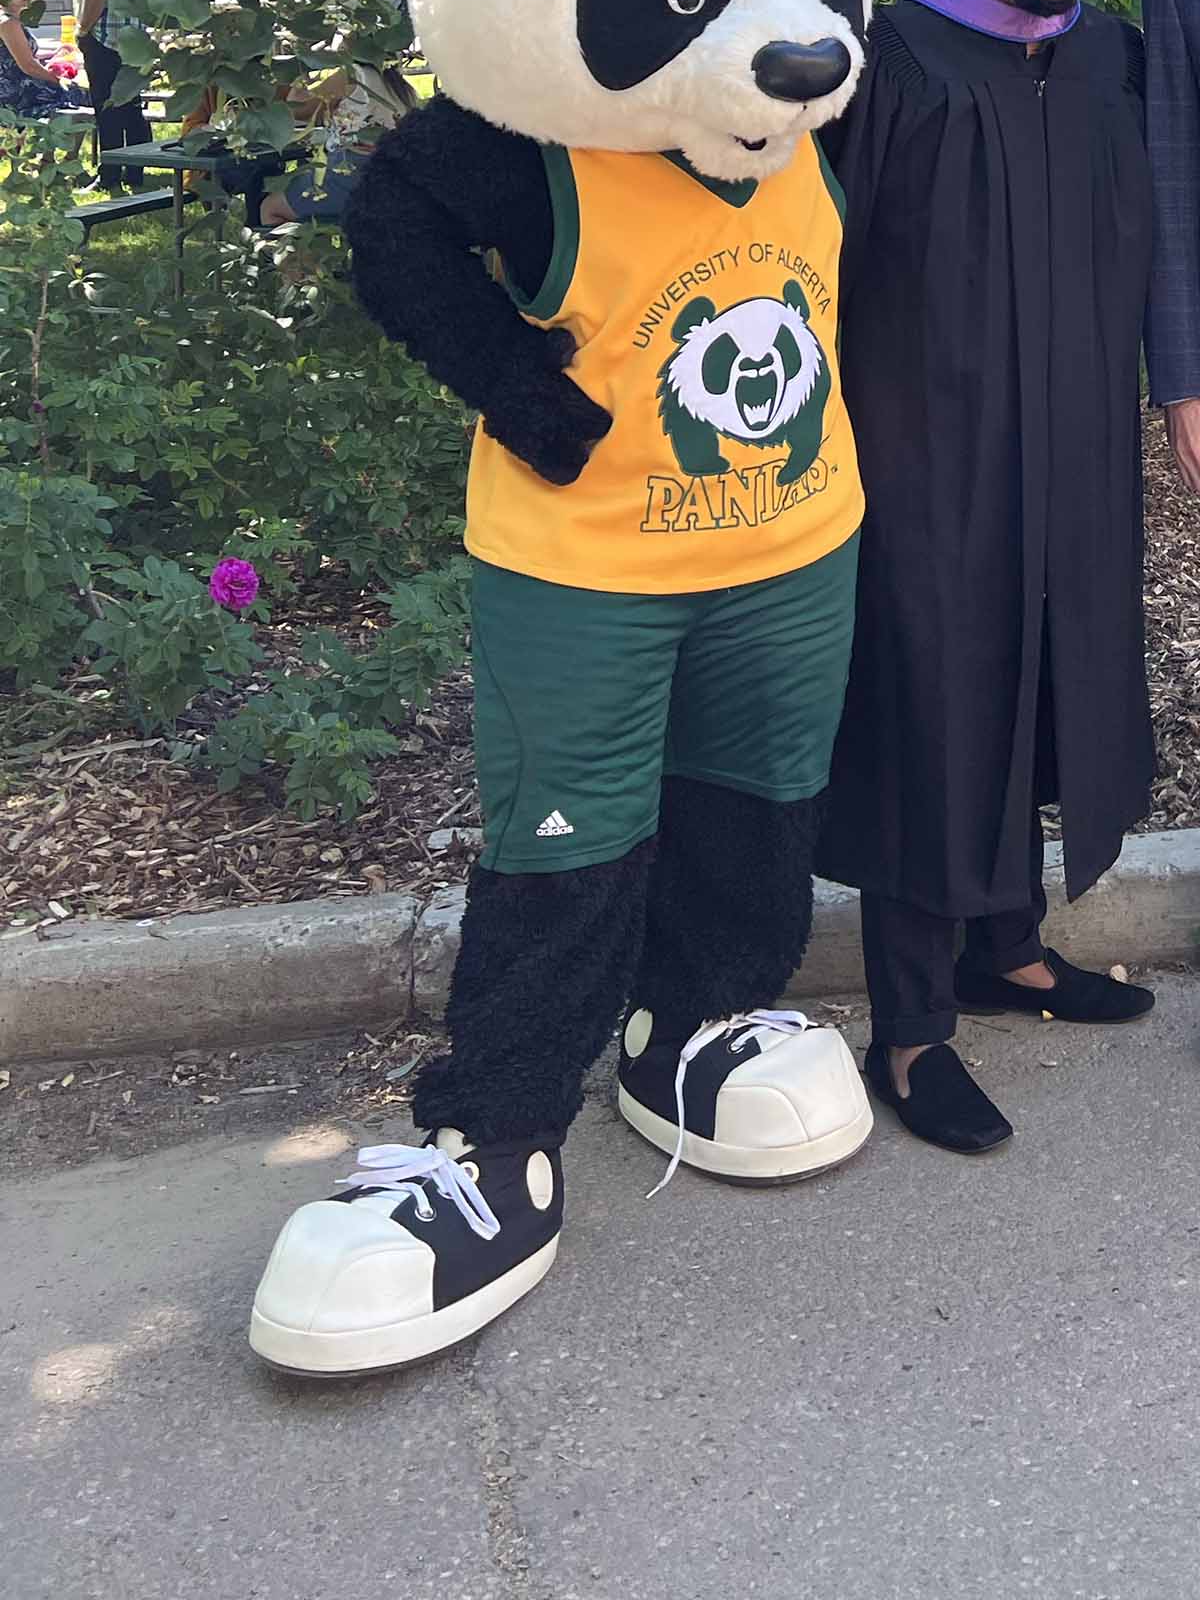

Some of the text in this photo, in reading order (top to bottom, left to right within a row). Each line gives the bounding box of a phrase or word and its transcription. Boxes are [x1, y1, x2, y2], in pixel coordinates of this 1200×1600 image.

[632, 242, 833, 350] UNIVERSITY OF ALBERTA
